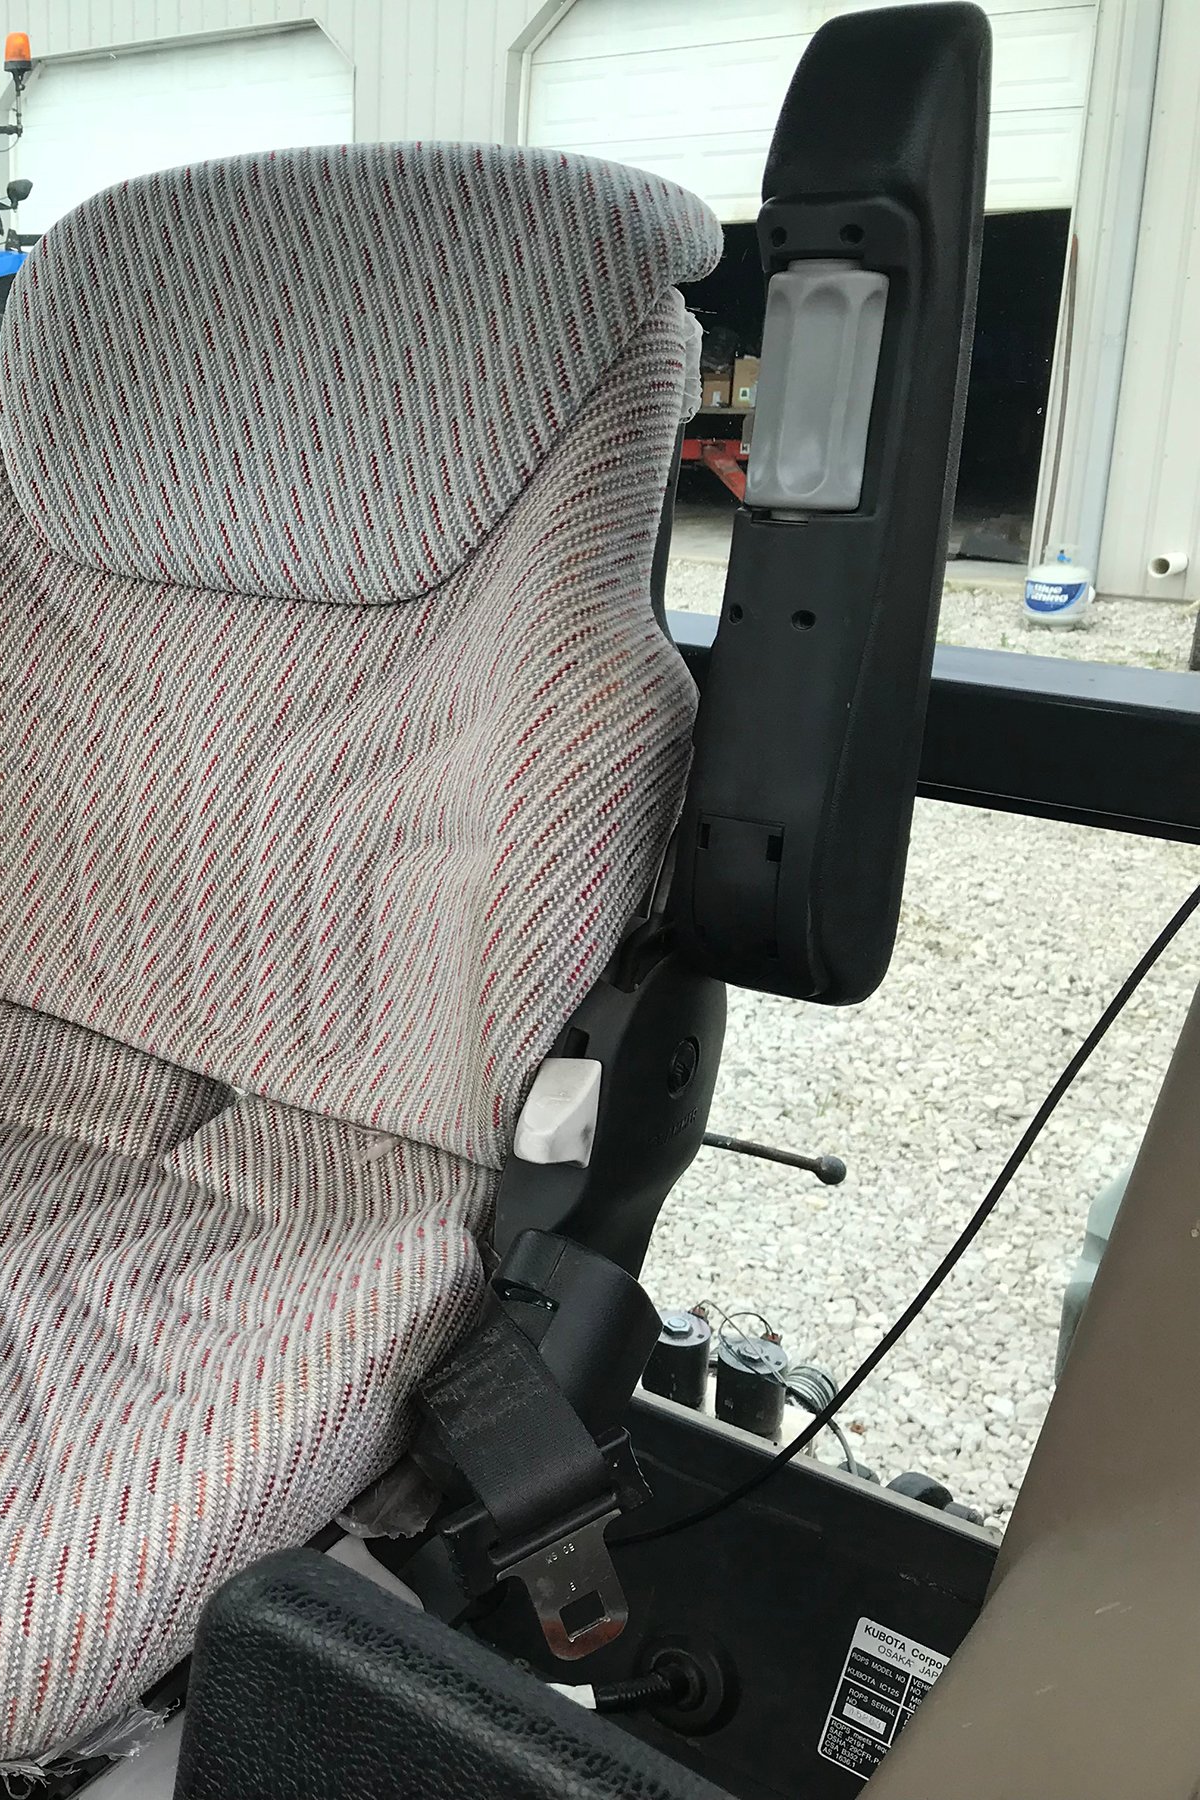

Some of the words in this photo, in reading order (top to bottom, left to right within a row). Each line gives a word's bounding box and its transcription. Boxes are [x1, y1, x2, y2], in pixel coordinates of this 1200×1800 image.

[864, 1624, 906, 1653] KUBOTA
[851, 1651, 870, 1667] ROPS
[871, 1660, 894, 1679] MODEL
[918, 1666, 939, 1680] JAP
[847, 1667, 876, 1687] KUBOTA
[848, 1688, 869, 1703] ROPS
[870, 1698, 896, 1718] SERIAL
[829, 1727, 844, 1739] SAE
[831, 1719, 851, 1735] ROPS
[822, 1746, 833, 1757] AS
[824, 1740, 839, 1752] CSA
